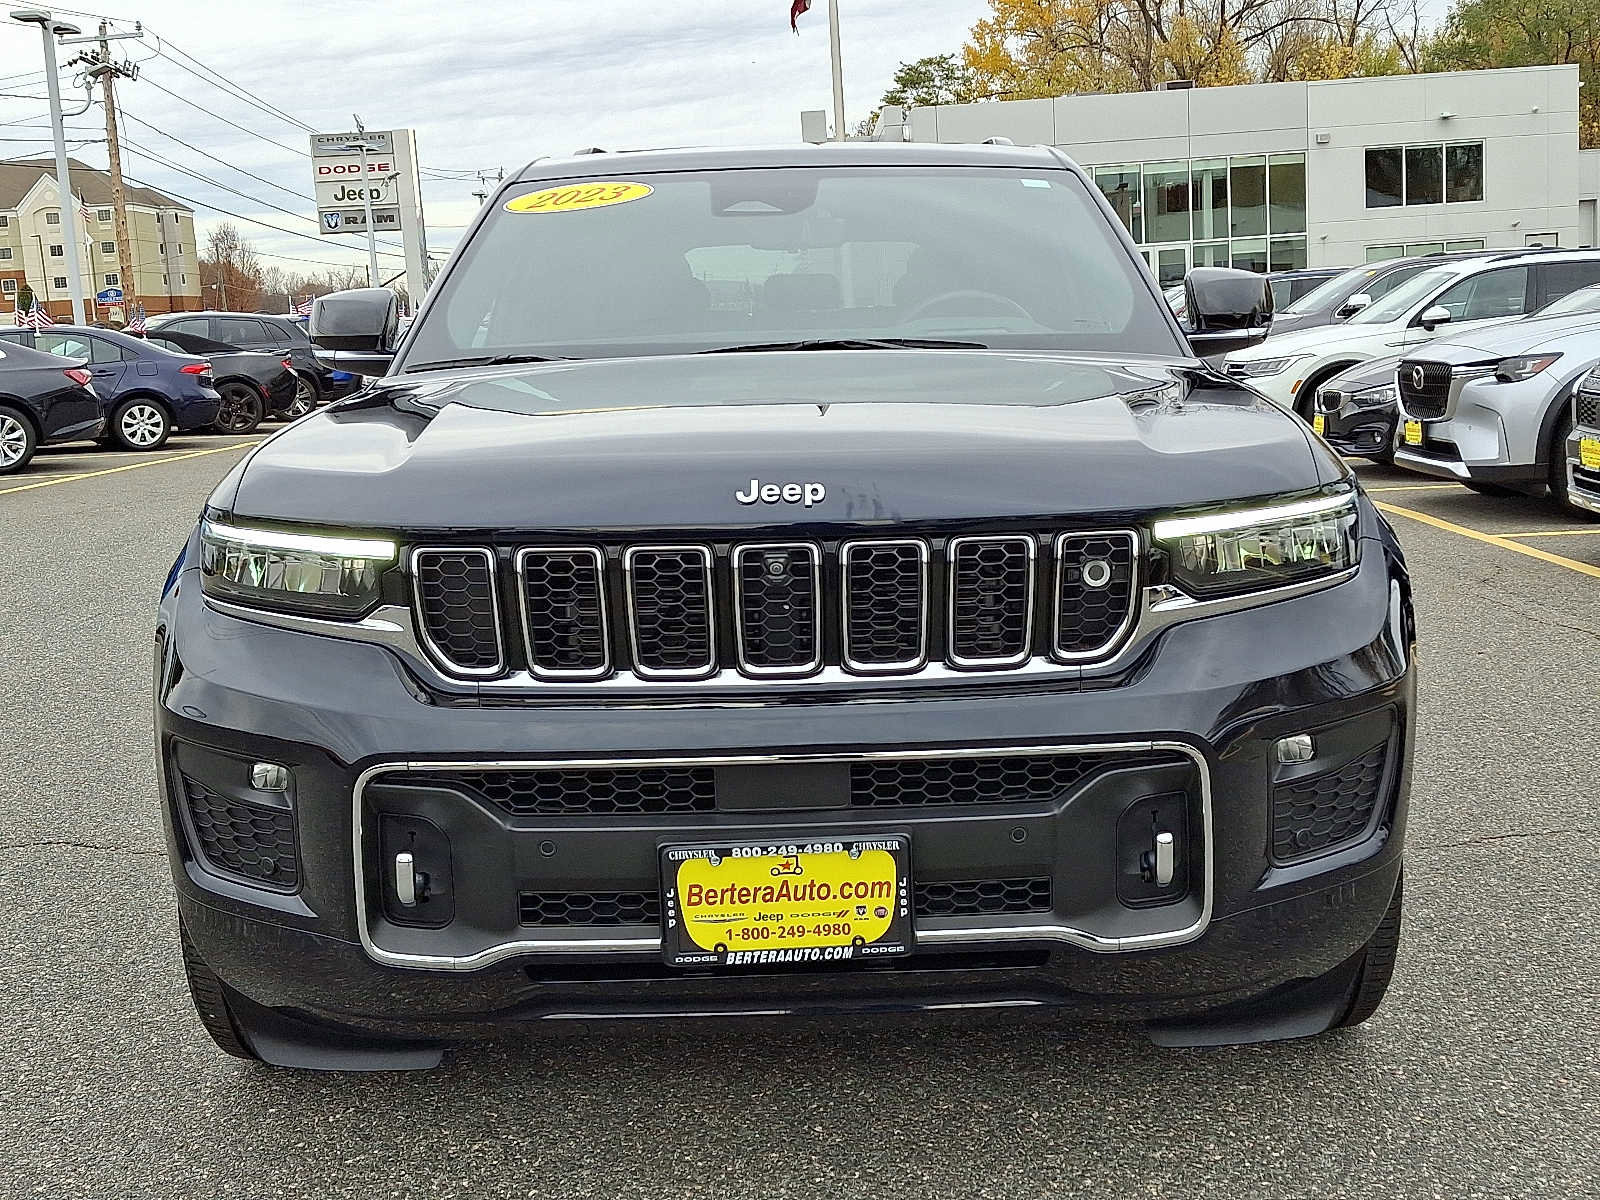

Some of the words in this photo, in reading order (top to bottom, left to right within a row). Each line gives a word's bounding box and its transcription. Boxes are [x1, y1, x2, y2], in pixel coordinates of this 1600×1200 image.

[525, 185, 631, 210] 2023
[735, 479, 826, 509] Jeep
[668, 849, 716, 860] CHRYSLER
[731, 843, 844, 858] 800-249-4980
[852, 841, 900, 851] CHRYSLER
[687, 879, 892, 907] BerteraAuto.com
[899, 877, 909, 917] Jeep
[666, 888, 677, 928] Jeep
[753, 911, 784, 922] Jeep
[726, 923, 851, 941] 1-800-249-4980
[726, 946, 854, 965] BERTERAAUTO.COM
[862, 945, 905, 954] DODGE
[674, 955, 718, 963] DODGE
